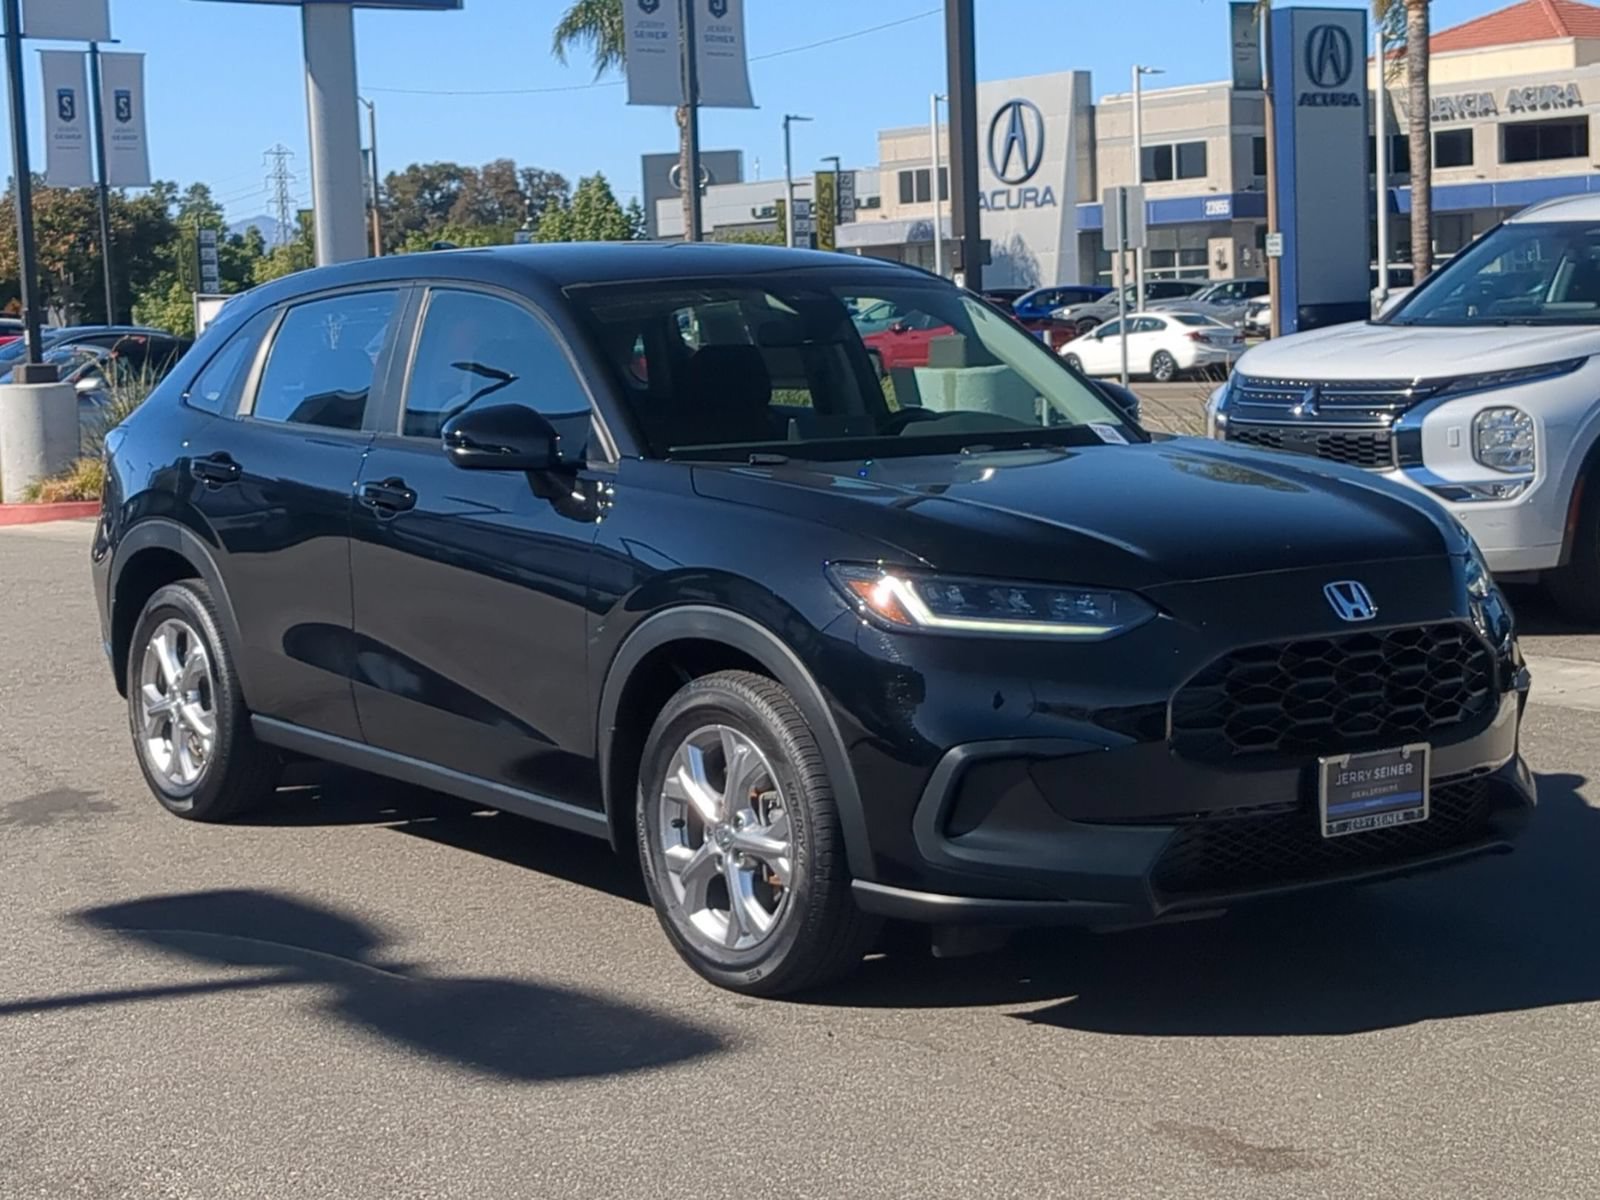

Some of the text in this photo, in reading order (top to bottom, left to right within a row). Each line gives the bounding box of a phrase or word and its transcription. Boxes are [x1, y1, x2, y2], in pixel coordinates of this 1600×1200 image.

[1298, 92, 1361, 107] ACURA
[1505, 83, 1583, 112] ACURA
[978, 185, 1058, 212] ACURA
[1335, 762, 1413, 786] JERRY SEINER
